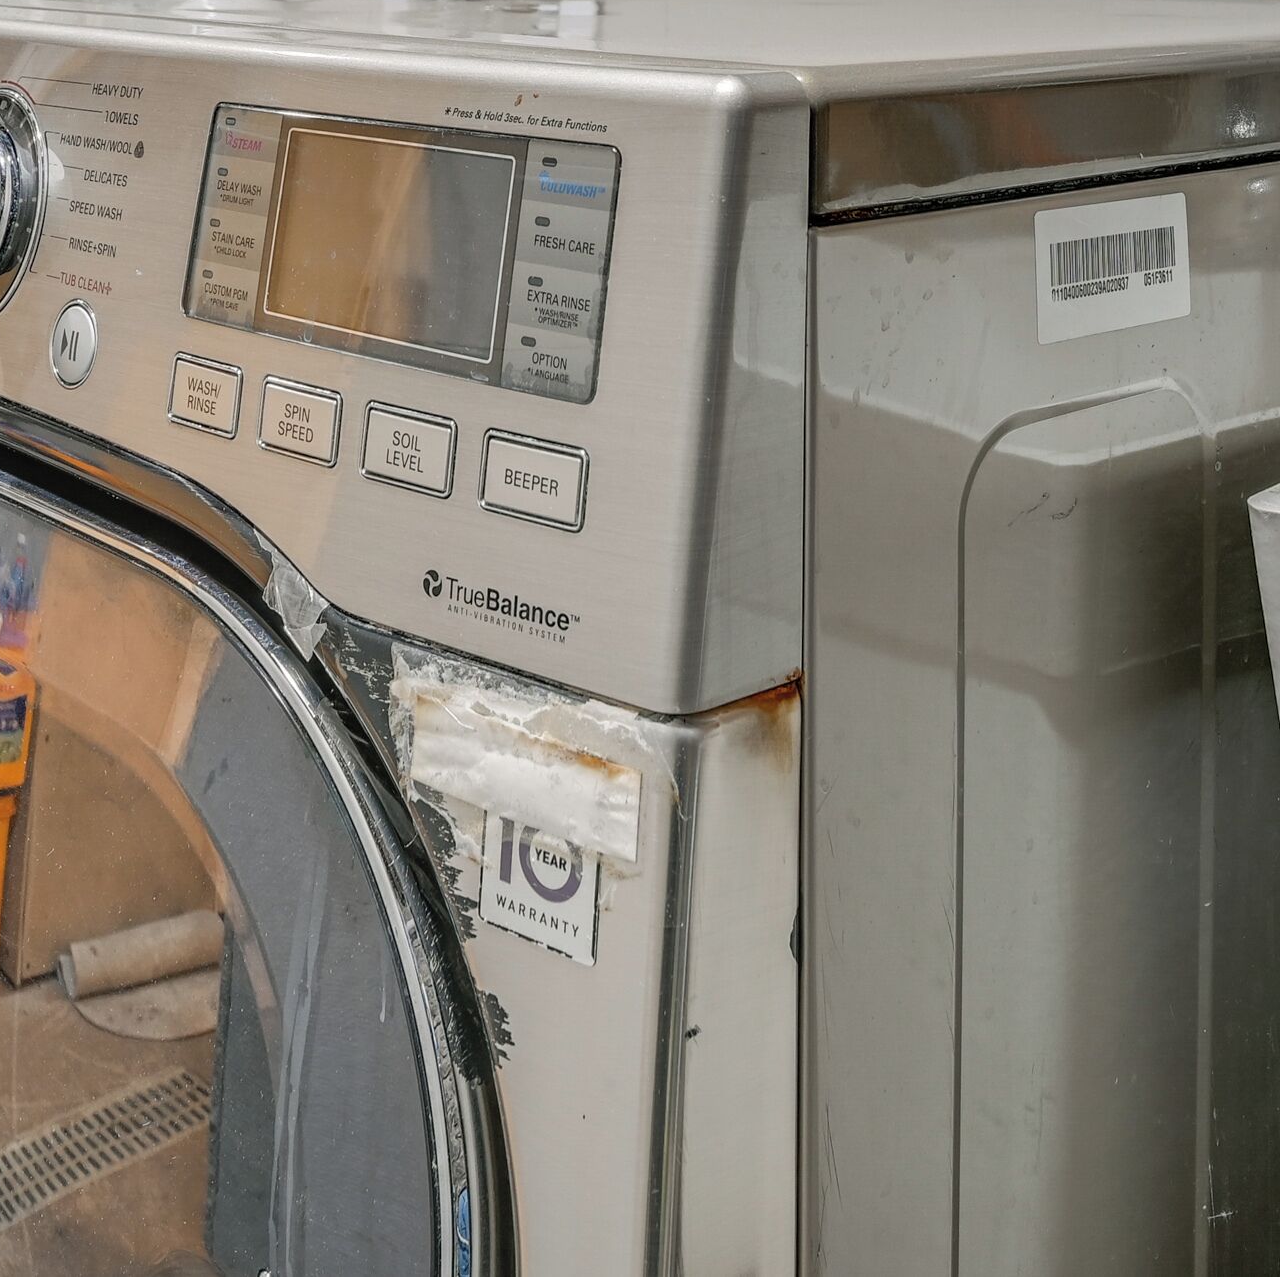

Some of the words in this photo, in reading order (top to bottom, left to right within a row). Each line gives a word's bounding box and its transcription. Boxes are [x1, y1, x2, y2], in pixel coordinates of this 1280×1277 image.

[92, 83, 118, 98] HEAVY
[120, 86, 144, 100] DUTY
[104, 110, 139, 127] TOWELS
[452, 108, 473, 120] Press
[475, 110, 482, 120] &
[483, 111, 503, 123] Hold
[527, 115, 540, 127] for
[541, 117, 564, 129] Extra
[565, 119, 608, 133] Functions
[60, 133, 80, 149] HAND
[81, 136, 133, 155] WASH/WOOL
[231, 136, 262, 152] STEAM
[84, 169, 129, 188] DELICATES
[217, 179, 239, 193] DELAY
[240, 183, 262, 196] WASH
[69, 200, 92, 217] SPEED
[93, 204, 123, 222] WASH
[238, 197, 254, 207] LIGHT
[68, 237, 117, 259] RINSE+SPIN
[212, 231, 234, 245] STAIN
[235, 235, 255, 249] CARE
[534, 234, 566, 251] FRESH
[568, 239, 596, 256] CARE
[232, 249, 248, 259] LOCK
[60, 272, 77, 287] TUB
[77, 275, 105, 294] CLEAN
[204, 282, 232, 297] CUSTOM
[233, 287, 249, 301] PGM
[225, 300, 239, 311] SAVE
[526, 289, 560, 306] EXTRA
[561, 295, 591, 312] RINSE
[539, 308, 579, 322] WASH/RINSE
[532, 351, 568, 370] OPTION
[187, 376, 221, 400] WASH/
[187, 393, 217, 417] RINSE
[284, 403, 311, 424] SPIN
[278, 421, 314, 444] SPEED
[392, 430, 421, 453] SOIL
[386, 449, 424, 474] LEVEL
[504, 468, 559, 498] BEEPER
[447, 604, 524, 633] ANTI-VIBRATION
[529, 626, 566, 644] SYSTEM
[499, 816, 584, 904] 10
[535, 847, 568, 872] YEAR
[496, 893, 580, 938] WARRANTY
